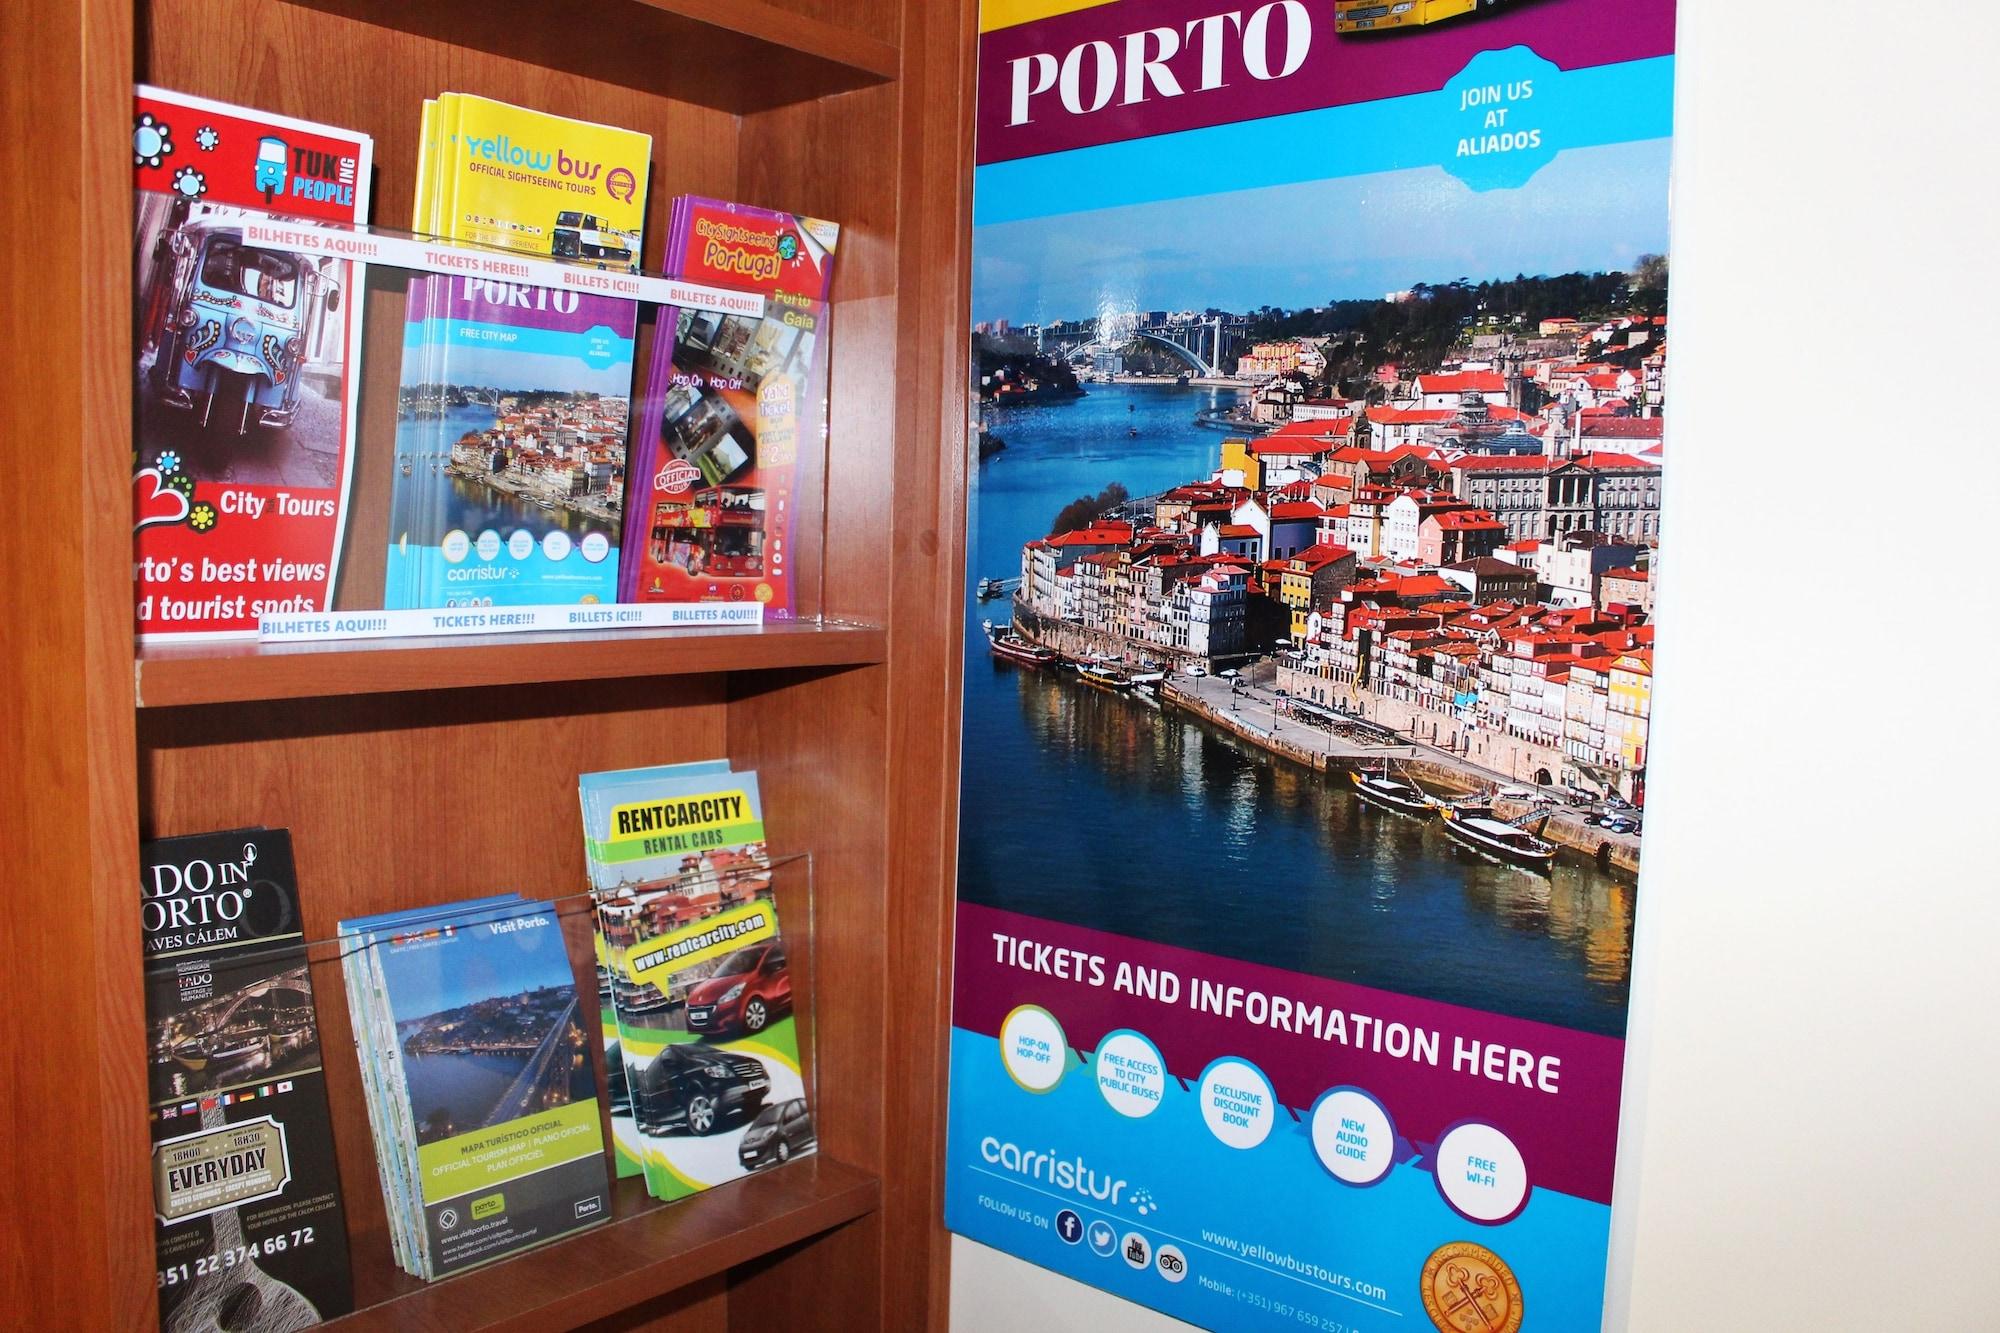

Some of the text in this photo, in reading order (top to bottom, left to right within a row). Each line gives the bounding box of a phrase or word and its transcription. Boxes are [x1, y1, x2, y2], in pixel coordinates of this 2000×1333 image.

[1005, 0, 1312, 127] PORTO
[1460, 80, 1533, 111] JOIN US
[1484, 108, 1508, 128] AT
[1456, 129, 1541, 157] ALIADOS
[293, 148, 339, 180] TUK
[338, 157, 355, 184] ING
[557, 149, 601, 180] bus
[469, 162, 506, 179] OFFICIAL
[508, 170, 562, 190] SIGHTSEEING
[566, 182, 596, 196] TOURS
[292, 176, 352, 206] PEOPLE
[248, 226, 378, 256] BILHETES AQUI!!!
[425, 251, 529, 278] TICKETS HERE!!!
[706, 243, 780, 278] Portugal
[564, 272, 640, 294] BILLETS ICI!!!
[462, 276, 580, 314] PORTO
[670, 288, 759, 312] BILLETES AQUI!!!
[784, 312, 814, 328] Gaia
[460, 327, 517, 342] FREE CITY MAP
[672, 374, 743, 390] Hop On Hop Off
[660, 470, 698, 486] OFFICIAL
[220, 490, 266, 520] City
[276, 493, 335, 516] Tours
[201, 557, 258, 582] best
[262, 558, 326, 582] views
[448, 564, 508, 582] carristur
[160, 595, 246, 620] tourist
[569, 610, 642, 623] BILLETS ICI!!!
[672, 608, 758, 621] BILLETES AQUI!!!
[262, 618, 387, 635] BILHETES AQUI!!!
[433, 612, 535, 628] TICKETS HERE!!!
[618, 796, 742, 834] RENTCARCITY
[644, 829, 724, 855] RENTAL CARS
[186, 926, 238, 946] CÁLEM
[490, 918, 550, 936] Visit Porto.
[634, 914, 765, 972] www.rentcarcity.com
[178, 974, 212, 988] FADO
[992, 932, 1560, 1094] TICKETS AND INFORMATION HERE
[1016, 1047, 1051, 1064] HOP-OFF
[1018, 1036, 1050, 1052] HOP-ON
[1104, 1052, 1158, 1075] FREE ACCESS
[1116, 1068, 1146, 1084] TO CITY
[1100, 1076, 1160, 1102] PUBLIC BUSES
[1213, 1084, 1262, 1106] EXCLUSIVE
[1214, 1097, 1261, 1118] DISCOUNT
[1222, 1112, 1249, 1128] BOOK
[1341, 1118, 1365, 1133] NEW
[234, 1133, 260, 1147] 18H30
[461, 1120, 563, 1156] MAPA TURÍSTICO OFICIAL
[1336, 1130, 1368, 1148] AUDIO
[173, 1148, 201, 1162] 18H00
[432, 1123, 592, 1177] OFFICIAL TOURISM MAP PLANO OFICIAL
[1336, 1144, 1367, 1161] GUIDE
[169, 1148, 266, 1192] EVERYDAY
[487, 1161, 508, 1173] PLAN
[981, 1136, 1127, 1206] carristur
[1468, 1156, 1496, 1173] FREE
[1466, 1170, 1495, 1188] WI-FI
[978, 1194, 1049, 1230] FOLLOW US ON
[196, 1255, 220, 1276] 22
[223, 1243, 260, 1268] 374
[264, 1234, 287, 1254] 66
[291, 1226, 314, 1247] 72
[1202, 1228, 1387, 1302] www.yellowbustours.com
[1198, 1275, 1343, 1333] Mobile: (+351) 967 659 257
